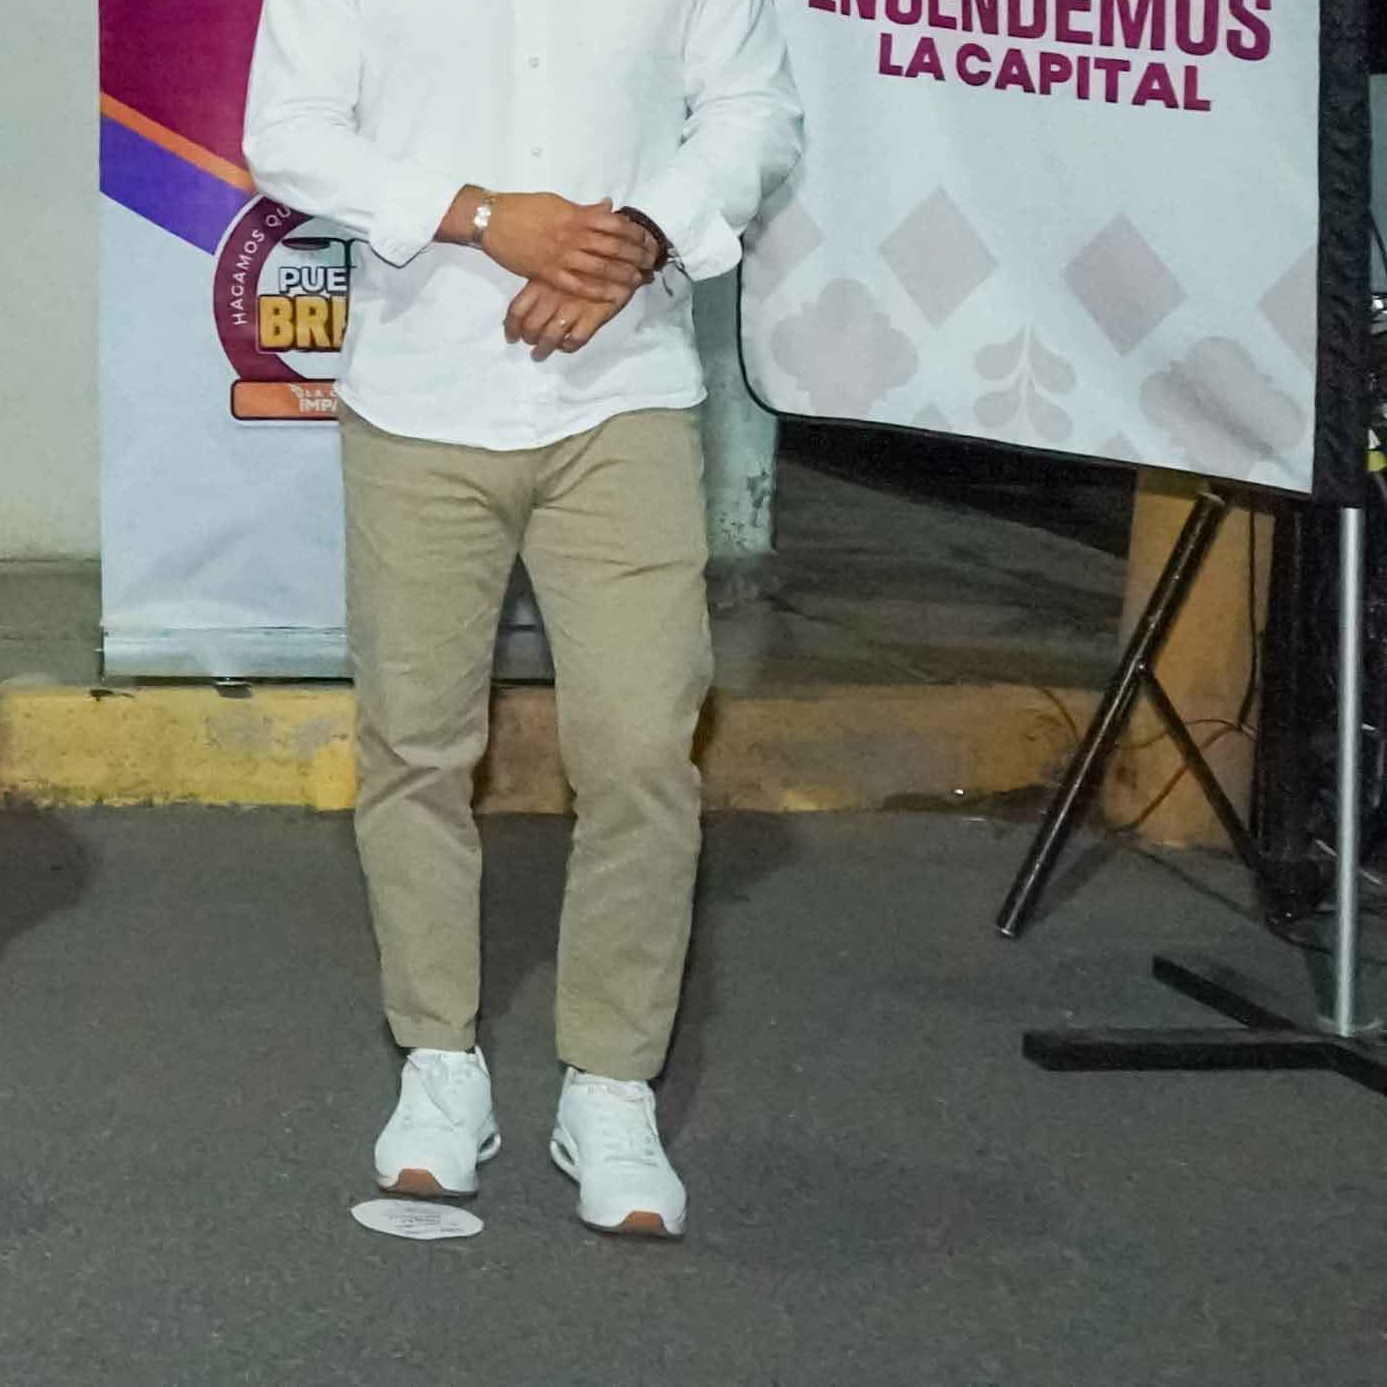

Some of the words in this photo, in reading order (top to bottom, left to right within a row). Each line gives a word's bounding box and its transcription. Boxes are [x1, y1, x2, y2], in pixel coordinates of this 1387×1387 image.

[878, 33, 946, 82] LA
[955, 42, 1212, 112] CAPITAL
[231, 228, 265, 325] HAGAMOS
